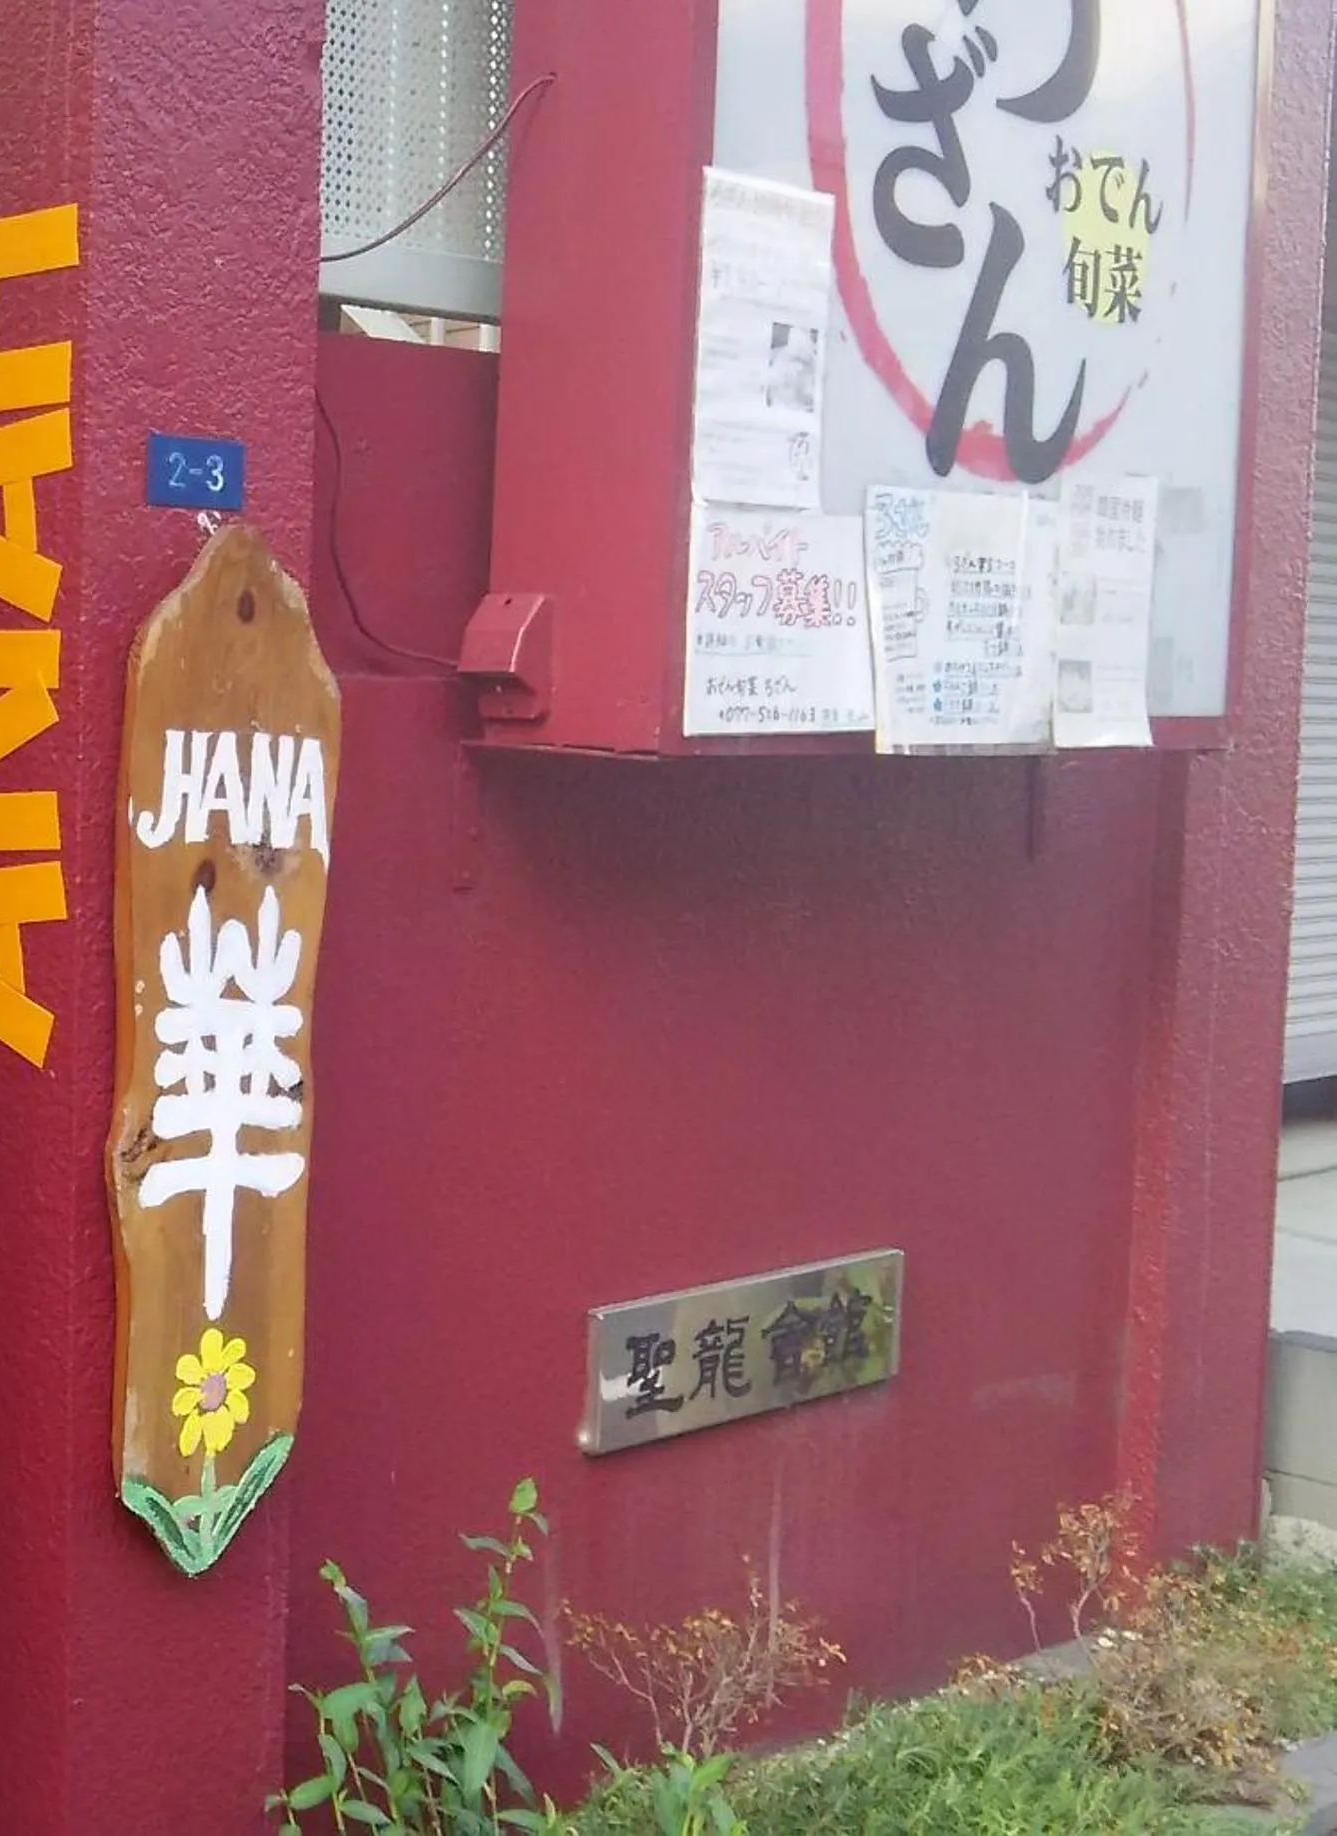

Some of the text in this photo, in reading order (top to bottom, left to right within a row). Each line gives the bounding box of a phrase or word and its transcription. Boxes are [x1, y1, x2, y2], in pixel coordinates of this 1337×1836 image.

[1045, 135, 1163, 235] おでん
[1063, 236, 1142, 324] 旬菜
[167, 451, 225, 493] 2-3
[136, 729, 330, 873] HANA
